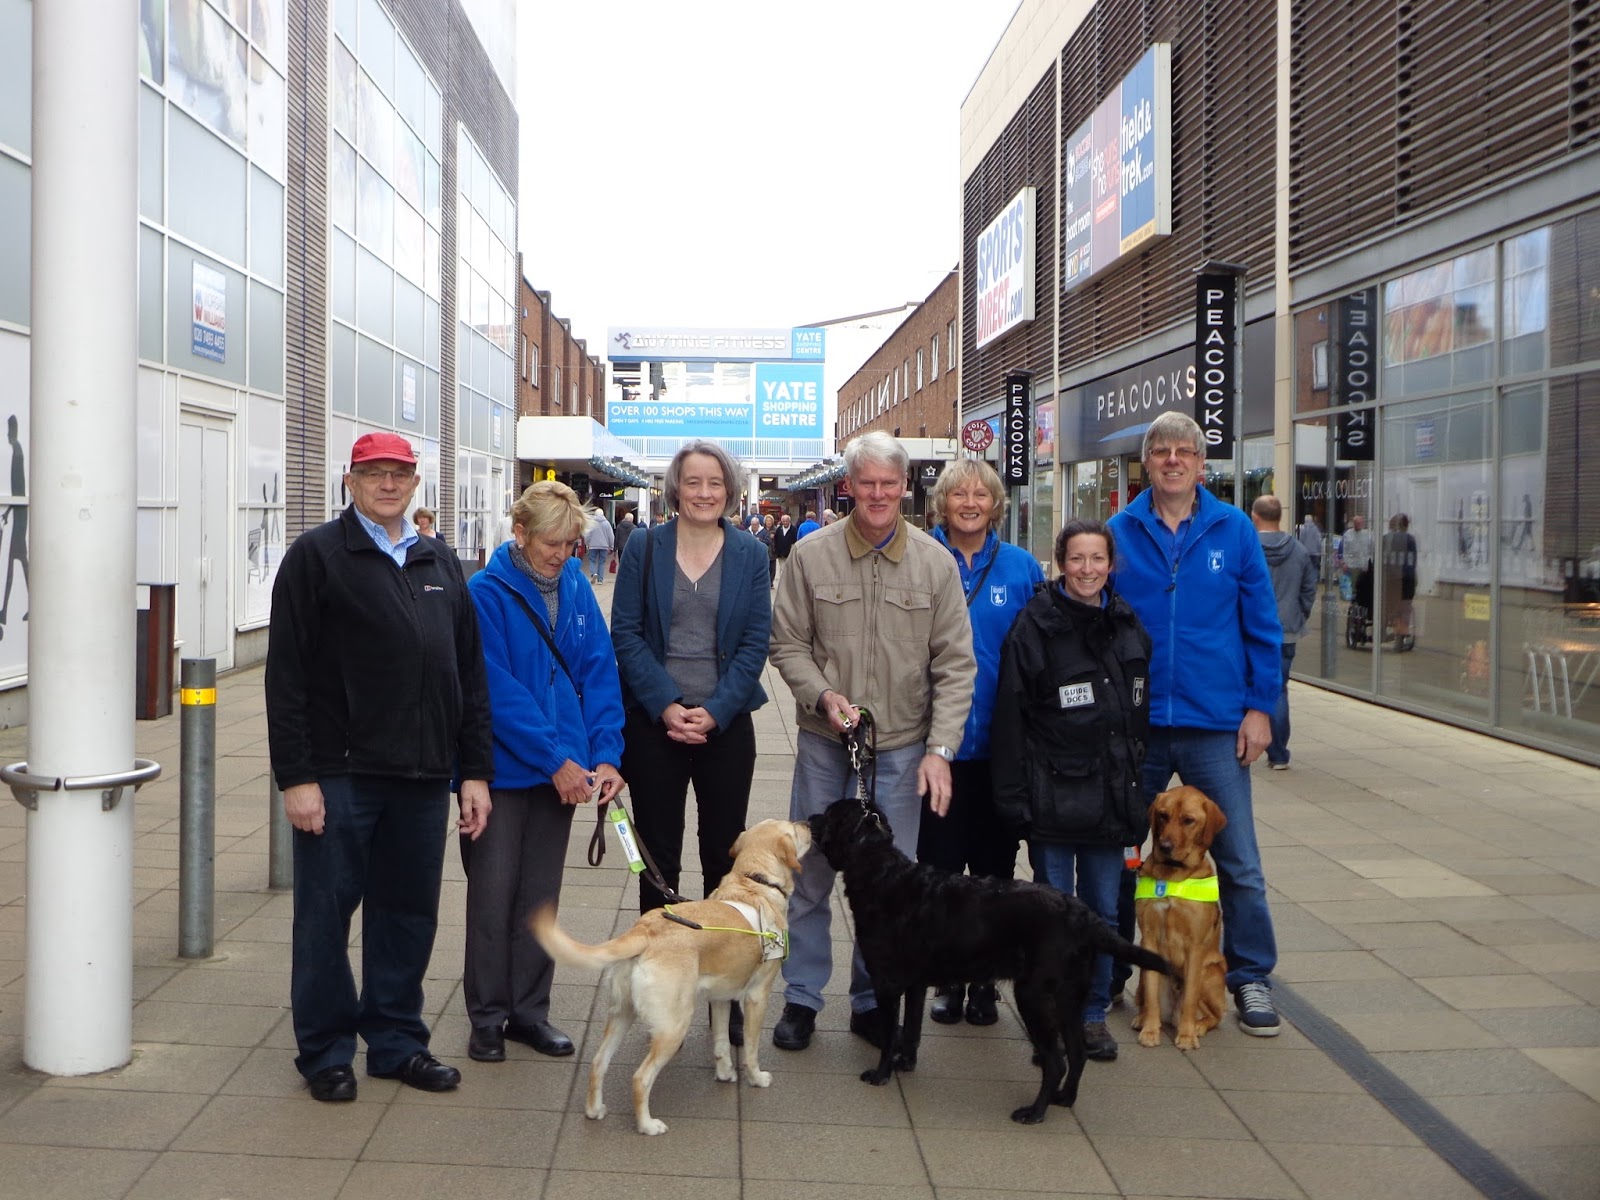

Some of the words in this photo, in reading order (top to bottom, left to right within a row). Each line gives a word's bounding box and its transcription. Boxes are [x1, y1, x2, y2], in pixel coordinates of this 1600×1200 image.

[1122, 146, 1154, 197] trek.com
[979, 199, 1023, 294] SPORTS
[632, 335, 711, 349] ANYTIME
[713, 336, 786, 350] FITNESS
[796, 332, 822, 342] YATE
[1204, 289, 1225, 446] PEACOCKS
[762, 380, 817, 401] YATE
[1097, 365, 1196, 421] PEACOCKS
[611, 405, 640, 416] OVER
[643, 406, 659, 416] 100
[661, 406, 697, 417] SHOPS
[698, 407, 722, 417] THIS
[725, 407, 749, 417] WAY
[762, 401, 817, 412] SHOPPING
[762, 413, 817, 426] CENTRE
[967, 422, 988, 431] COSTA
[1011, 384, 1024, 478] PEACOCKS
[966, 438, 990, 449] COFFEE
[1302, 481, 1324, 500] CLICK
[1335, 479, 1372, 499] COLLECT
[1064, 686, 1089, 696] GUIDE
